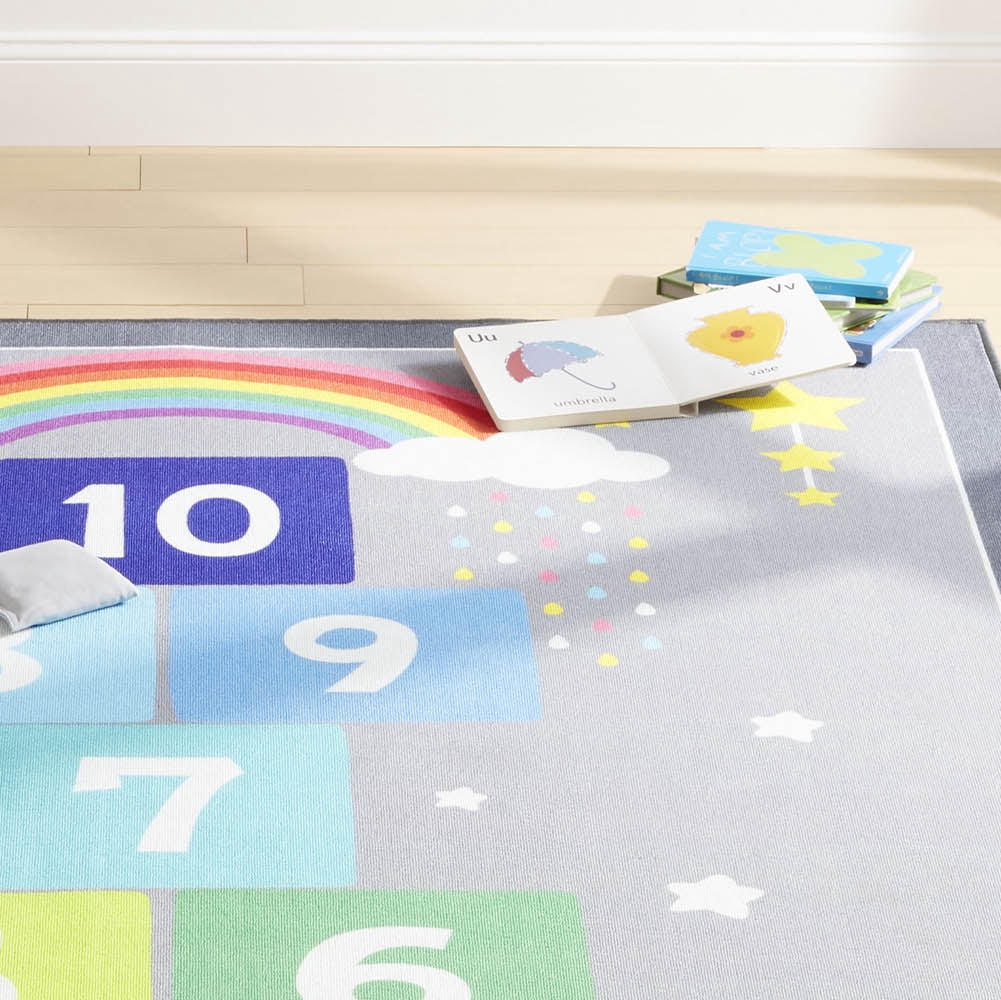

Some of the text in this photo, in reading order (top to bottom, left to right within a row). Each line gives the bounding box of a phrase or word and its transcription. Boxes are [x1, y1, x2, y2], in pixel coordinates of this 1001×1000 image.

[467, 333, 498, 344] Uu
[748, 365, 779, 377] vase
[553, 395, 617, 407] umbrella
[61, 483, 281, 559] 10
[282, 614, 419, 694] 9
[72, 755, 245, 853] 7
